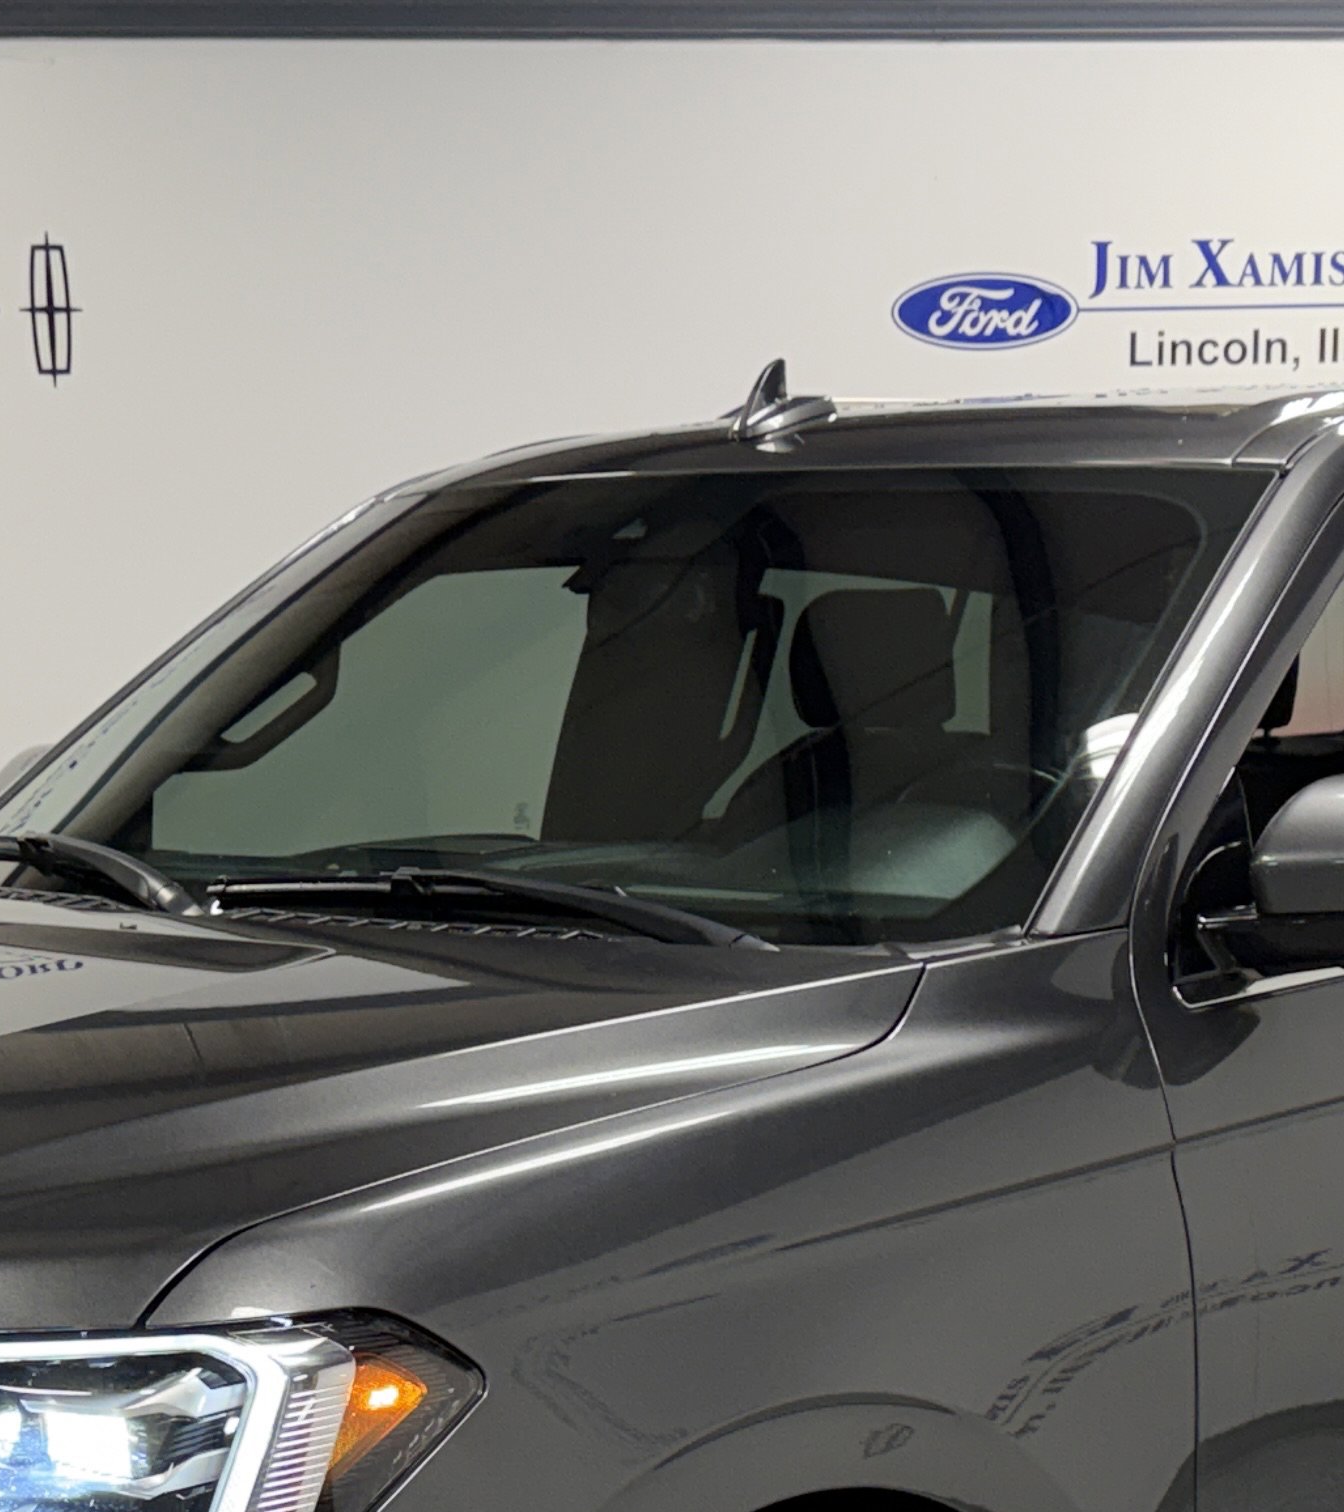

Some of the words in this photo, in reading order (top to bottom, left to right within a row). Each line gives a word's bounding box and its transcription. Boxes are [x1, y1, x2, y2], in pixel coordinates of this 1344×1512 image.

[1088, 241, 1173, 299] JIM
[928, 286, 1042, 336] Ford
[1129, 328, 1300, 371] Lincoln,
